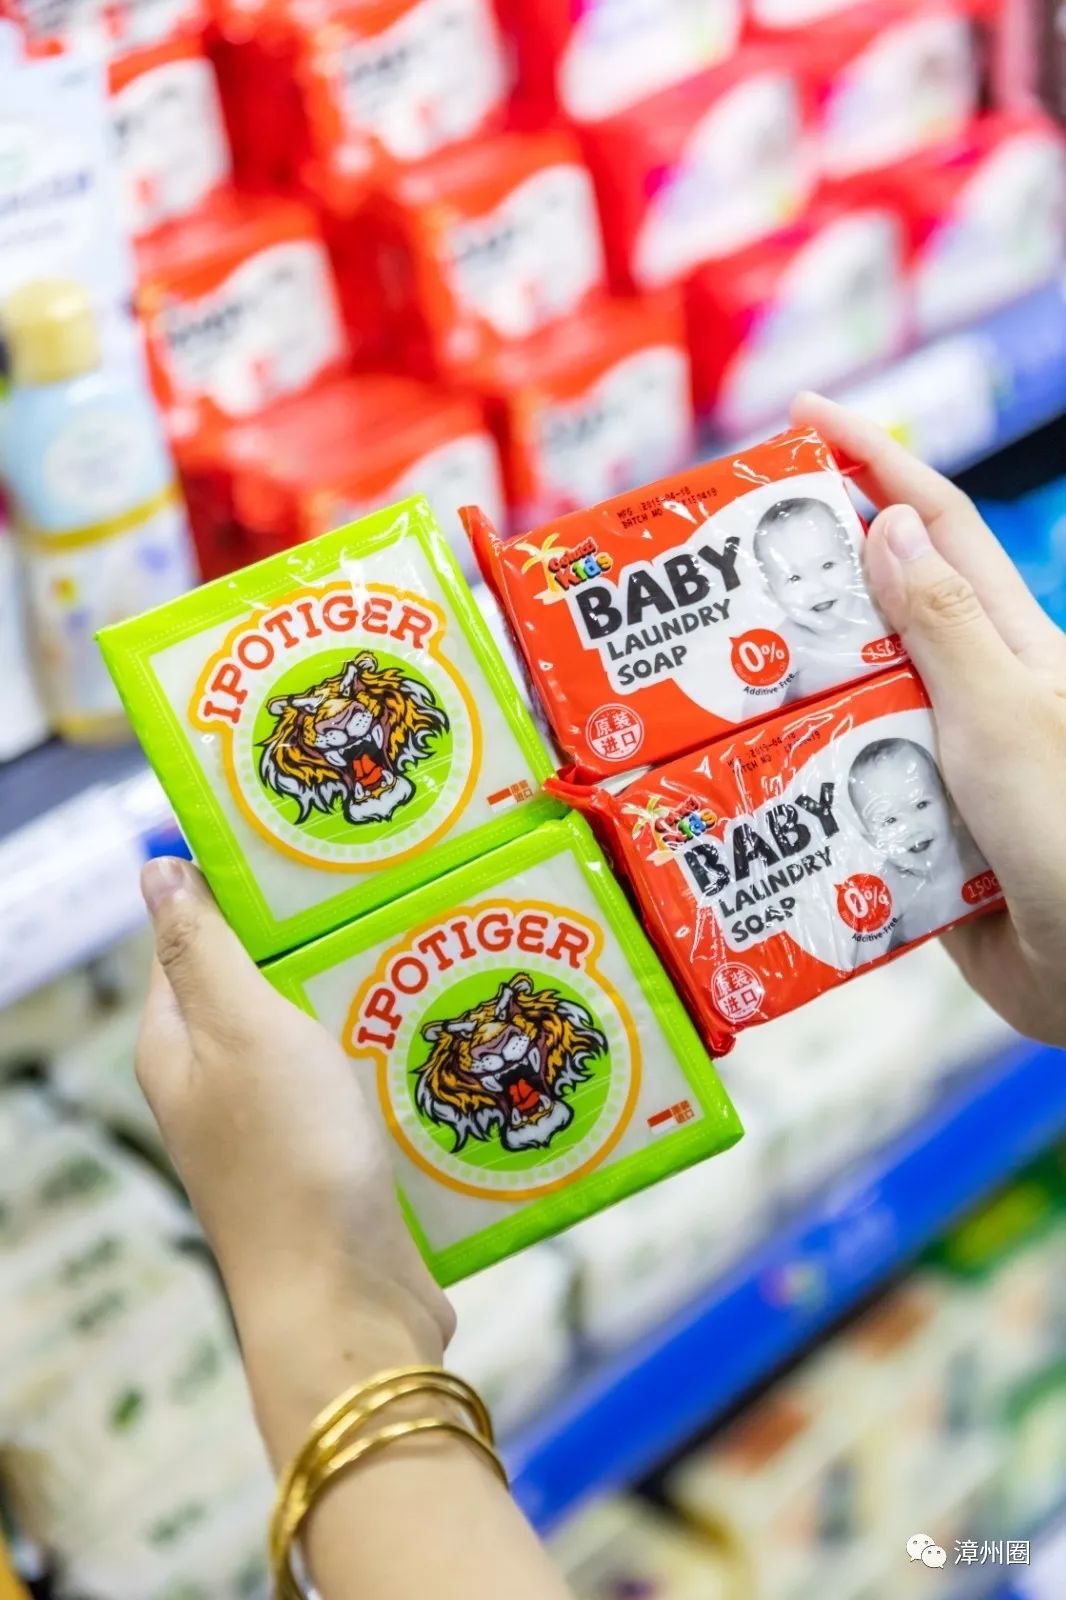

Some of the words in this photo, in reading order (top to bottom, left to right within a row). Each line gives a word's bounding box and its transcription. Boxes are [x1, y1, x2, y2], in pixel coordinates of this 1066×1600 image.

[575, 536, 742, 640] BABY
[606, 598, 732, 661] LAUNDRY
[203, 595, 433, 724] IPOTIGER
[617, 645, 688, 686] SOAP
[738, 641, 785, 673] 0%
[594, 709, 632, 737] 原装
[601, 730, 636, 756] 进口
[683, 781, 841, 898] BABY
[718, 846, 833, 919] LAUNDRY
[843, 886, 890, 919] 0%
[730, 896, 796, 944] SOAP
[357, 913, 590, 1050] IPOTIGER
[723, 988, 757, 1016] 进口
